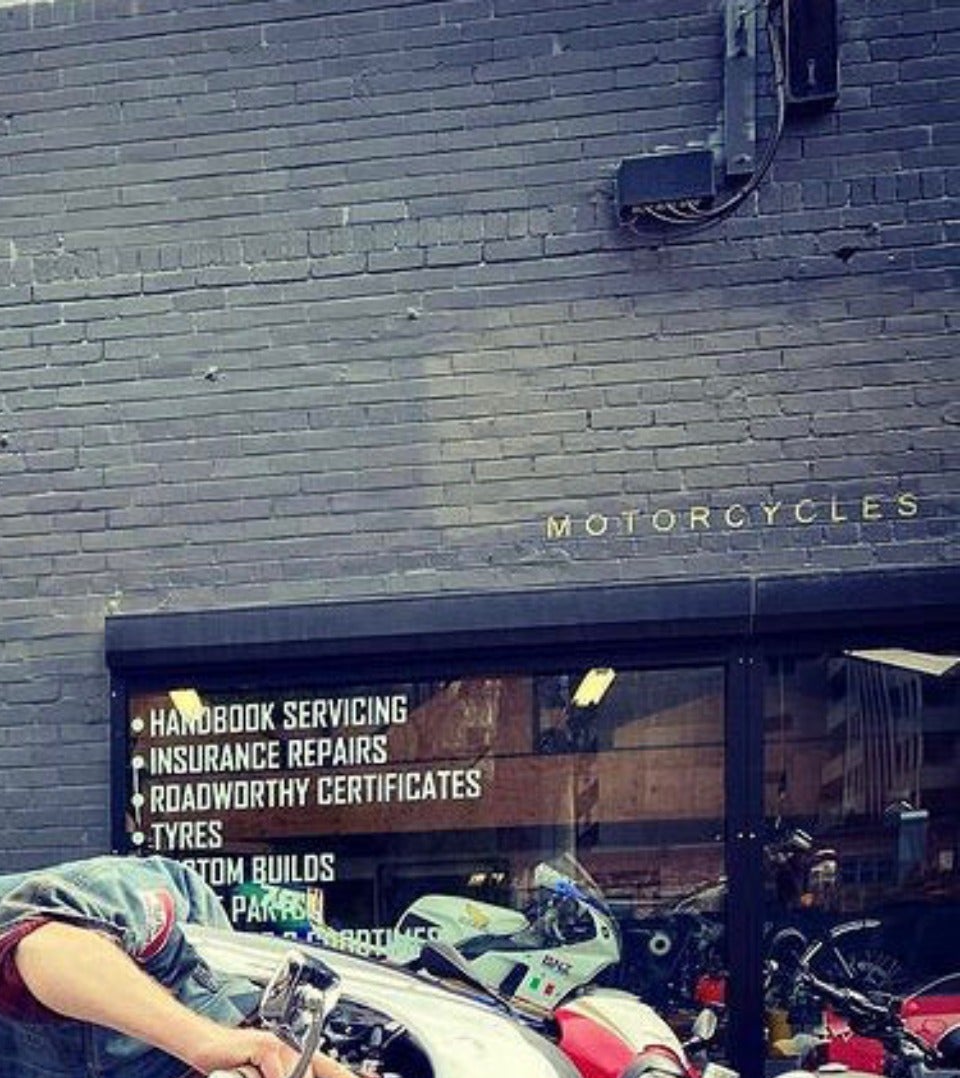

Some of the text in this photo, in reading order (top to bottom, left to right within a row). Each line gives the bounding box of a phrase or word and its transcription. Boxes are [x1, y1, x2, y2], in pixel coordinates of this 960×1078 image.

[546, 493, 918, 538] MOTORCYCLES
[150, 695, 408, 737] HANDBOOK SERVICING
[150, 735, 388, 775] INSURANCE REPAIRS
[150, 770, 482, 813] ROADWORTHY CERTIFICATES
[151, 821, 223, 851] TYRES
[184, 853, 335, 886] TOM BUILDS
